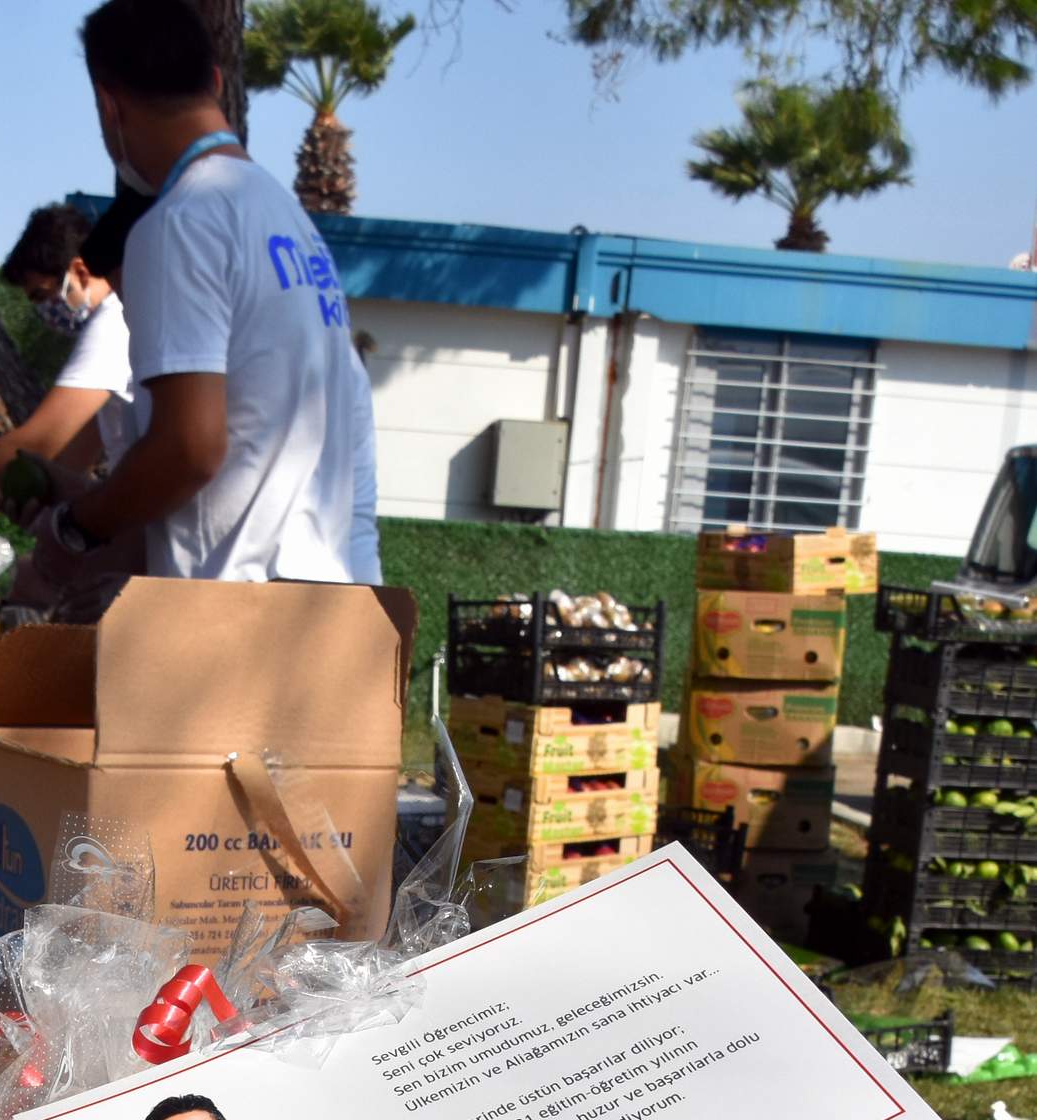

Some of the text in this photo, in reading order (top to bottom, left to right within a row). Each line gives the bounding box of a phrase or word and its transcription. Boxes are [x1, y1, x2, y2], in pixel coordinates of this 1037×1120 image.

[185, 833, 218, 851] 200
[224, 837, 243, 851] cc
[209, 871, 269, 891] ÜRETİCİ
[370, 1000, 511, 1067] Sevgili Öğrencimiz;
[381, 1016, 524, 1082] Seni çok seviyoruz.
[392, 972, 665, 1098] Sen bizim umudumuz, geleceğimizsin.
[403, 968, 721, 1113] Ülkemizin ve Aliağamızın sana ihtiyacı var...
[517, 1081, 563, 1107] üstün
[560, 1049, 628, 1087] başarılar
[629, 1024, 686, 1056] diliyor;
[621, 1087, 646, 1103] ve
[642, 1049, 727, 1093] başarılarla
[725, 1031, 761, 1055] dolu
[537, 1063, 651, 1120] eğitim-öğretim
[648, 1039, 700, 1070] yılının
